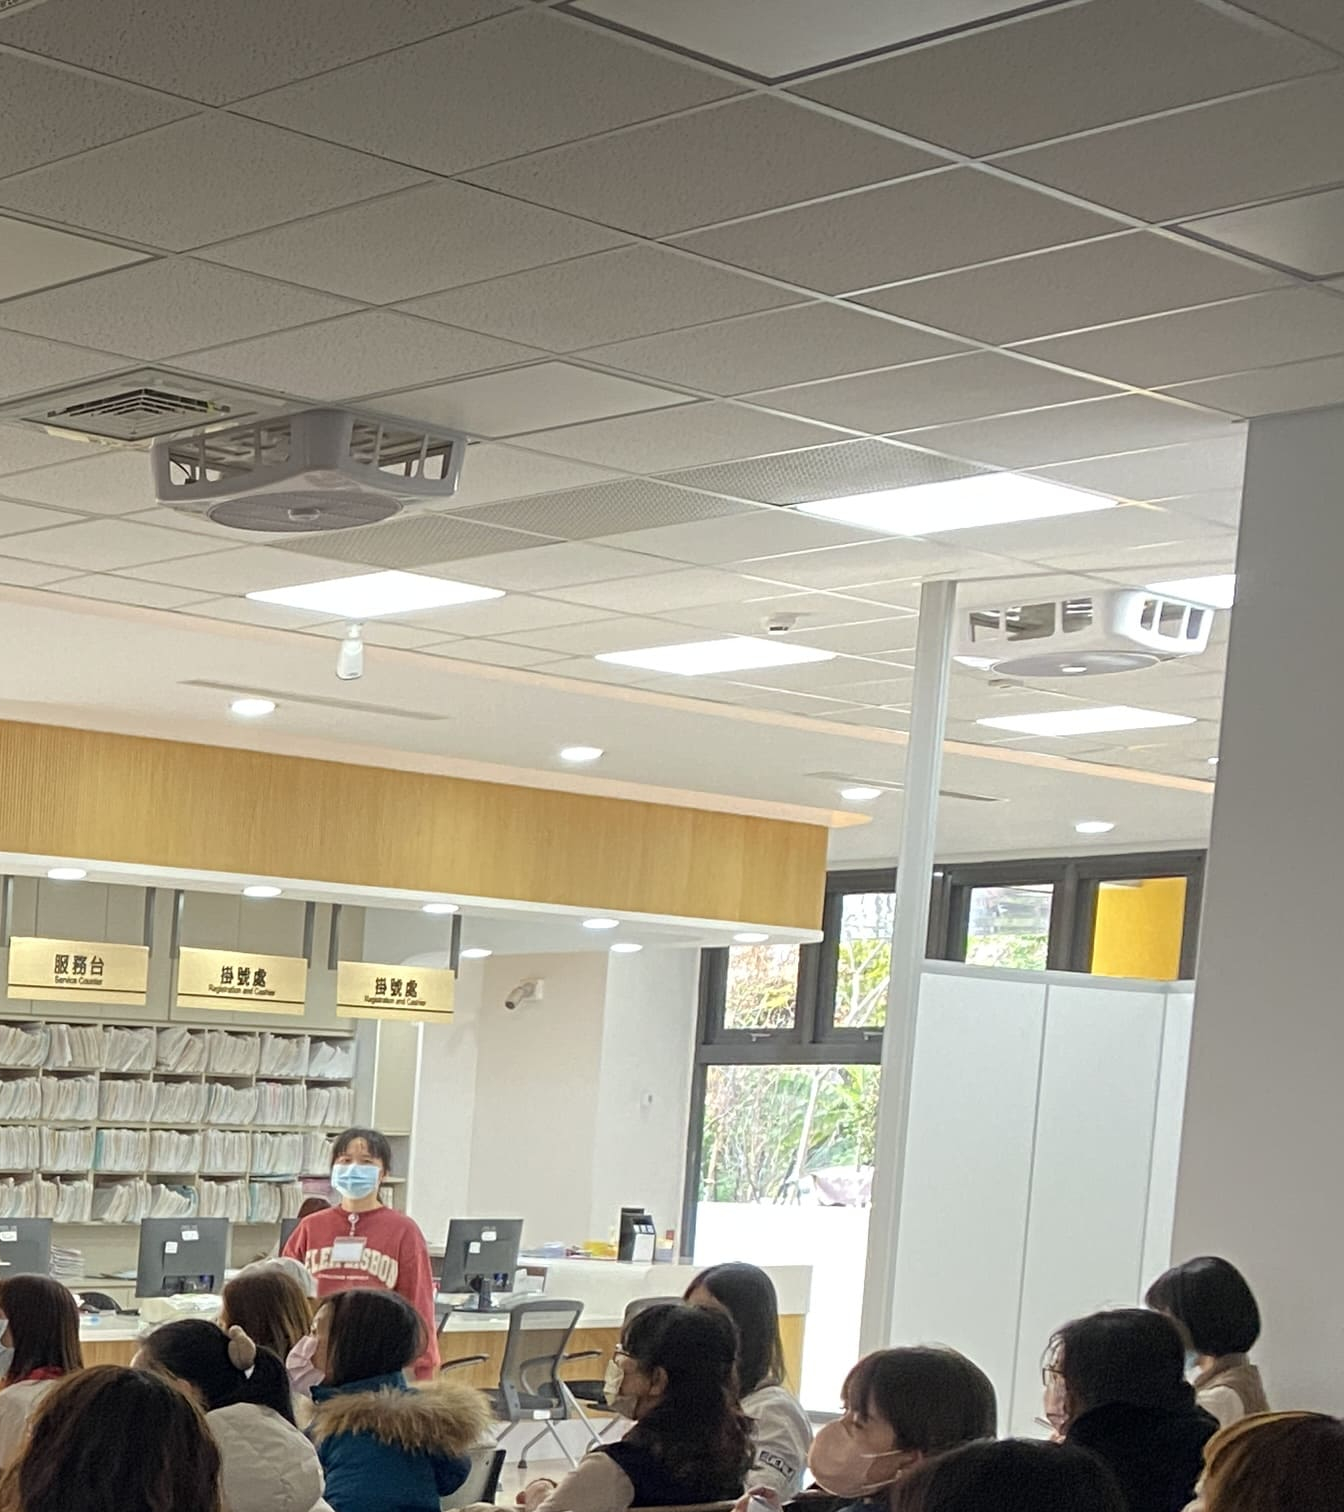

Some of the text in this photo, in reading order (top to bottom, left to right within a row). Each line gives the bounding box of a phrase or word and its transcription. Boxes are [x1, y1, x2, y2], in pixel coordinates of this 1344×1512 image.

[54, 953, 105, 976] 服務台
[55, 975, 77, 984] Service
[220, 965, 267, 988] 掛號處
[375, 976, 418, 998] 掛號處
